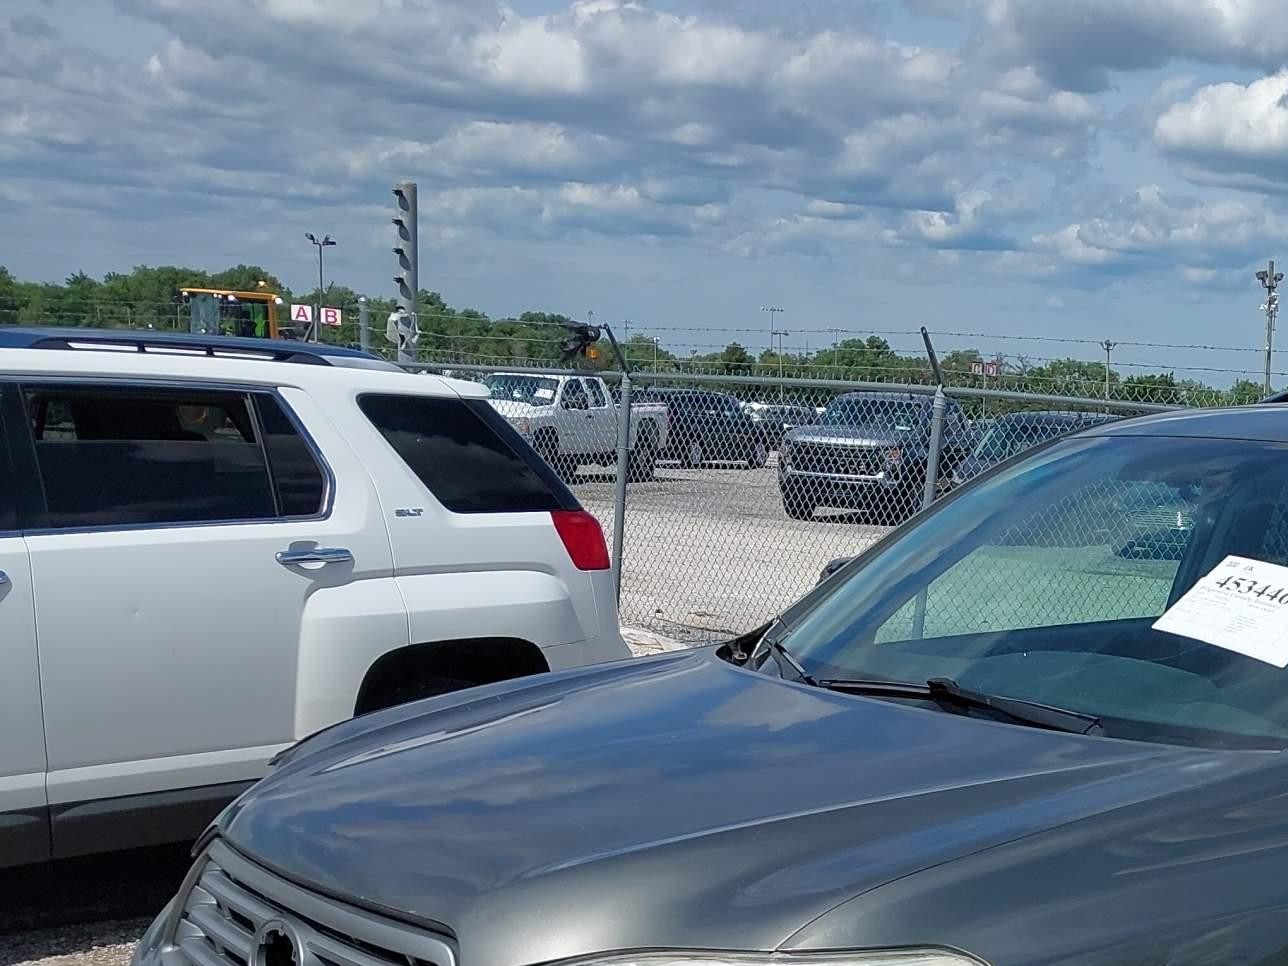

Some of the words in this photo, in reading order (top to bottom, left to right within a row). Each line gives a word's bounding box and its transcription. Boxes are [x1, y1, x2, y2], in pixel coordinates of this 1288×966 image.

[295, 305, 309, 320] A
[325, 308, 338, 324] B
[395, 508, 424, 517] SLT
